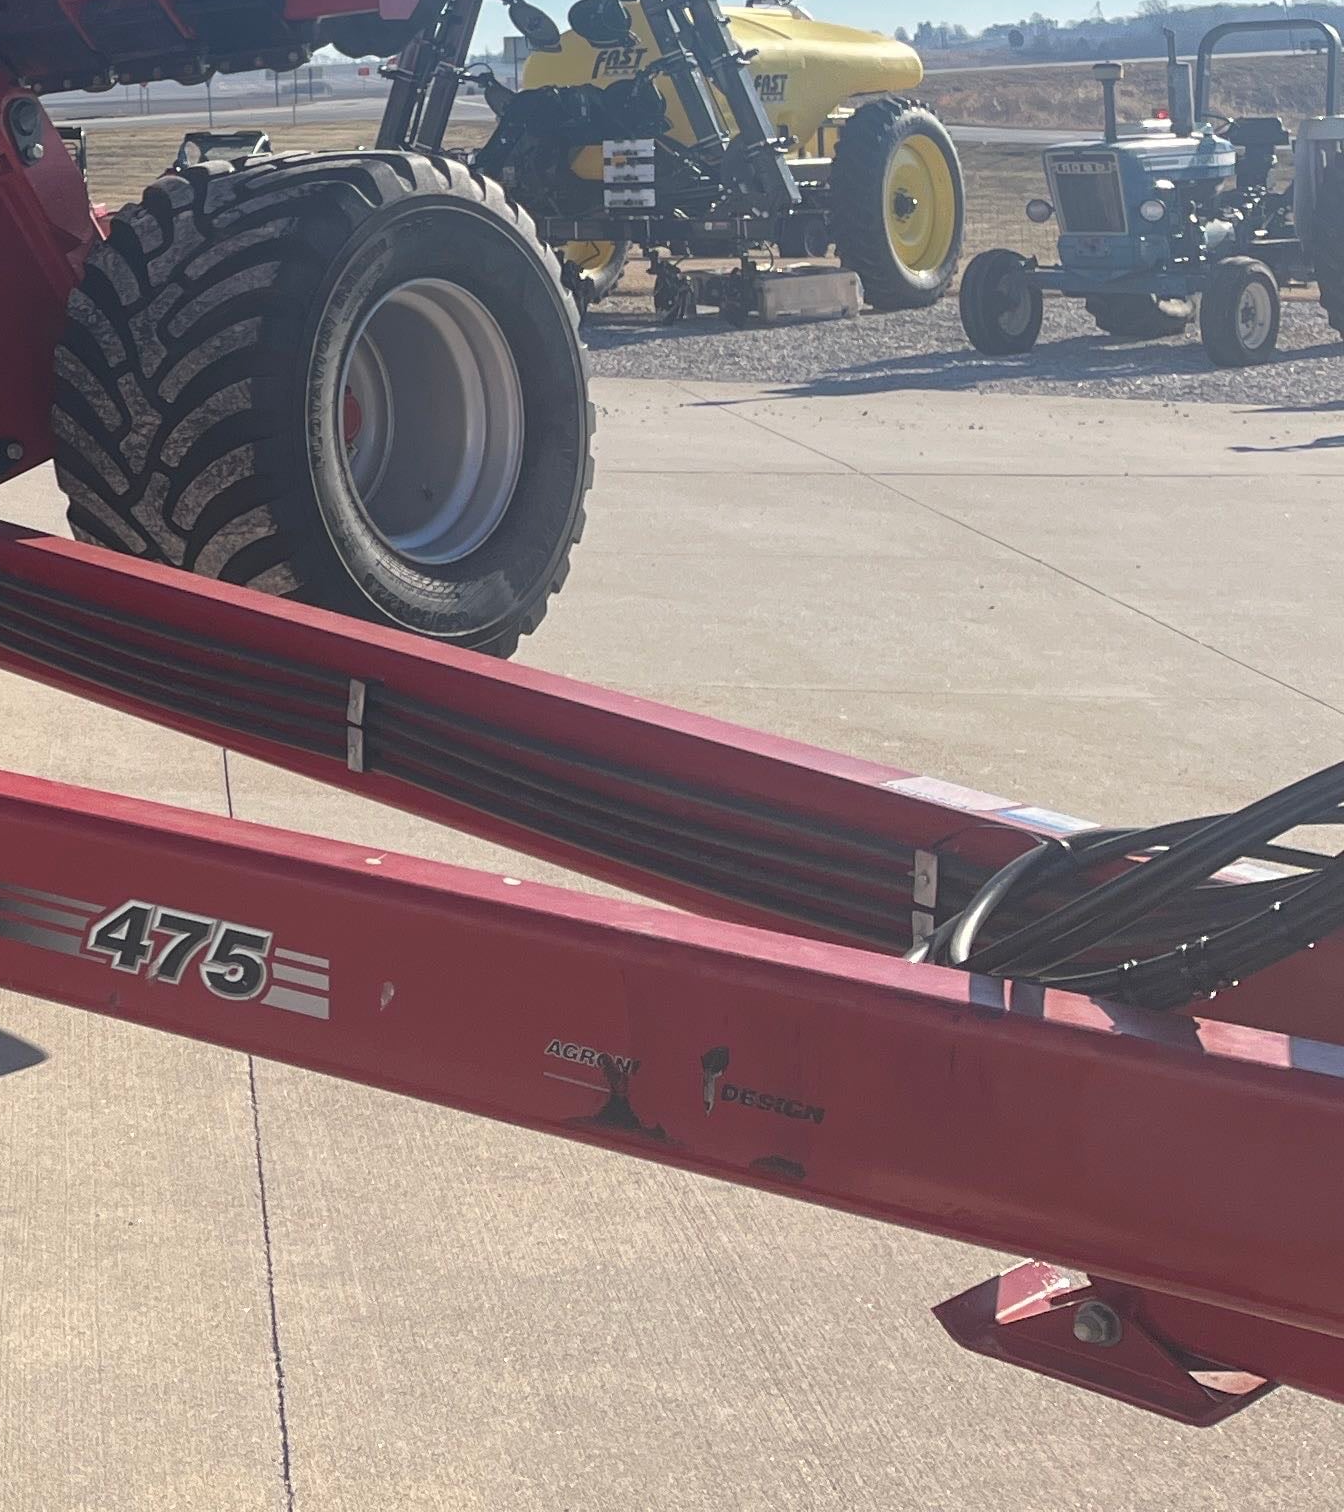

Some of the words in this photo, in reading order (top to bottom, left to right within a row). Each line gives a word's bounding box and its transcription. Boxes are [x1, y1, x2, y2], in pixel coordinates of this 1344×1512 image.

[592, 47, 649, 79] FAST
[753, 74, 788, 94] FAST
[86, 899, 273, 1001] 475
